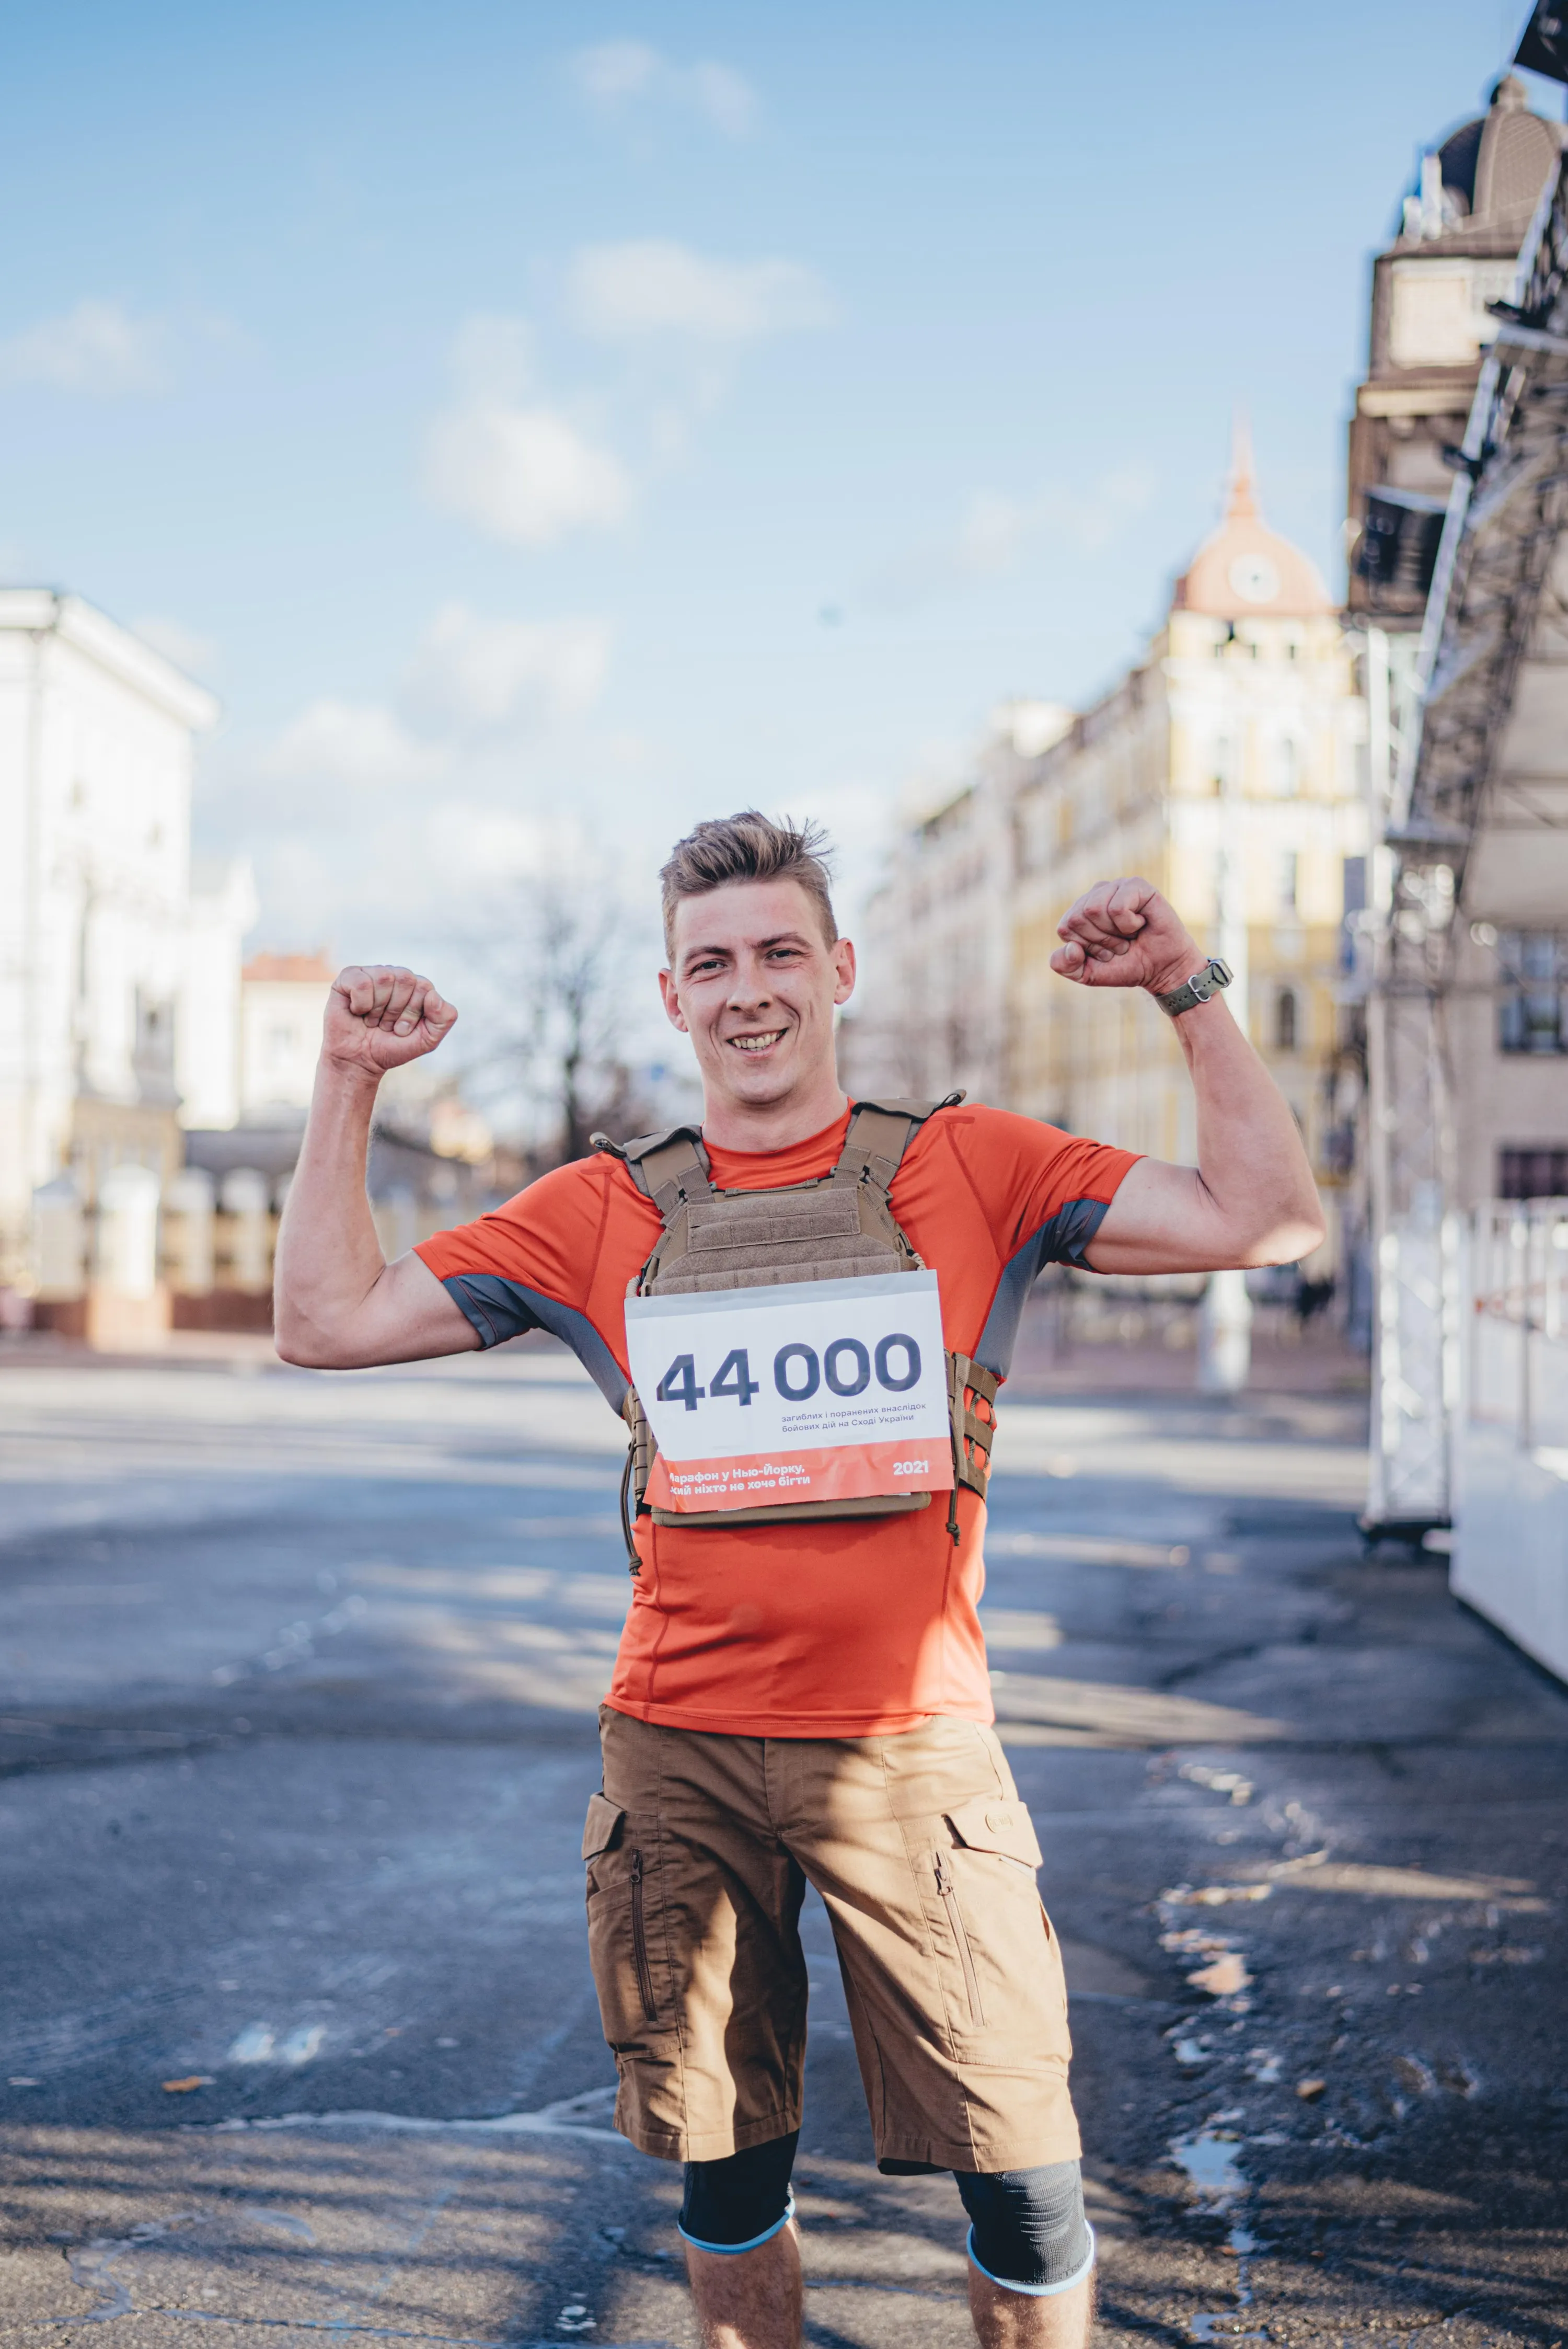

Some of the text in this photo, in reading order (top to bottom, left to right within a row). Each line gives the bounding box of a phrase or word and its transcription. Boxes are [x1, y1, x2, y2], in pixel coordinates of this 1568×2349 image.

[656, 1333, 922, 1412] 44 000
[781, 1412, 822, 1423] загиблих
[831, 1408, 879, 1419] поранених
[882, 1403, 926, 1413] внаслідок
[782, 1423, 820, 1433] бойових
[822, 1421, 836, 1429] дій
[851, 1417, 876, 1426] Сході
[879, 1415, 914, 1424] України
[721, 1472, 729, 1482] у
[733, 1464, 805, 1479] Нью-Йорку,
[893, 1461, 929, 1475] 2021
[670, 1476, 811, 1495] кий ніхто не хоче бігти
